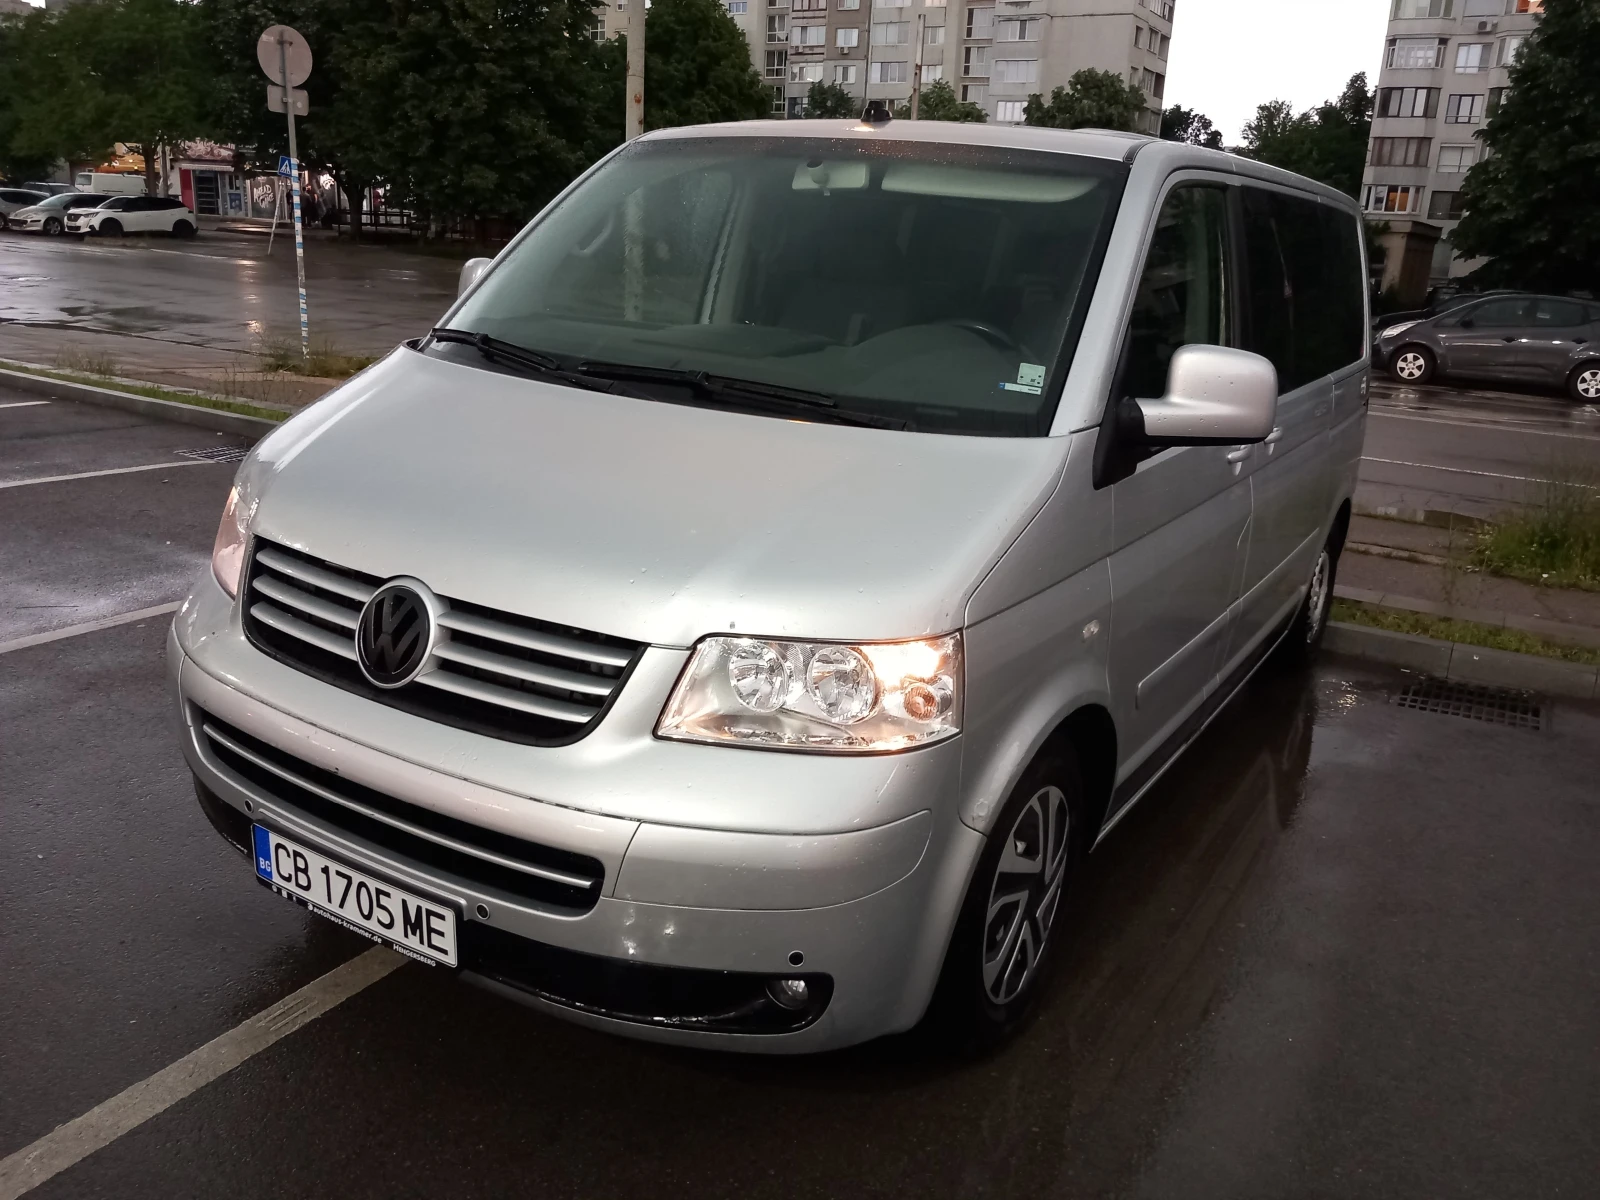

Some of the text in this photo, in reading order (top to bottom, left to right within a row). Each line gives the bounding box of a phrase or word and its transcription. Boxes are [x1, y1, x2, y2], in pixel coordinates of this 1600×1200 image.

[259, 857, 271, 871] BG
[274, 842, 449, 956] CB 1705 ME
[314, 907, 382, 943] autohaus-krammer.de
